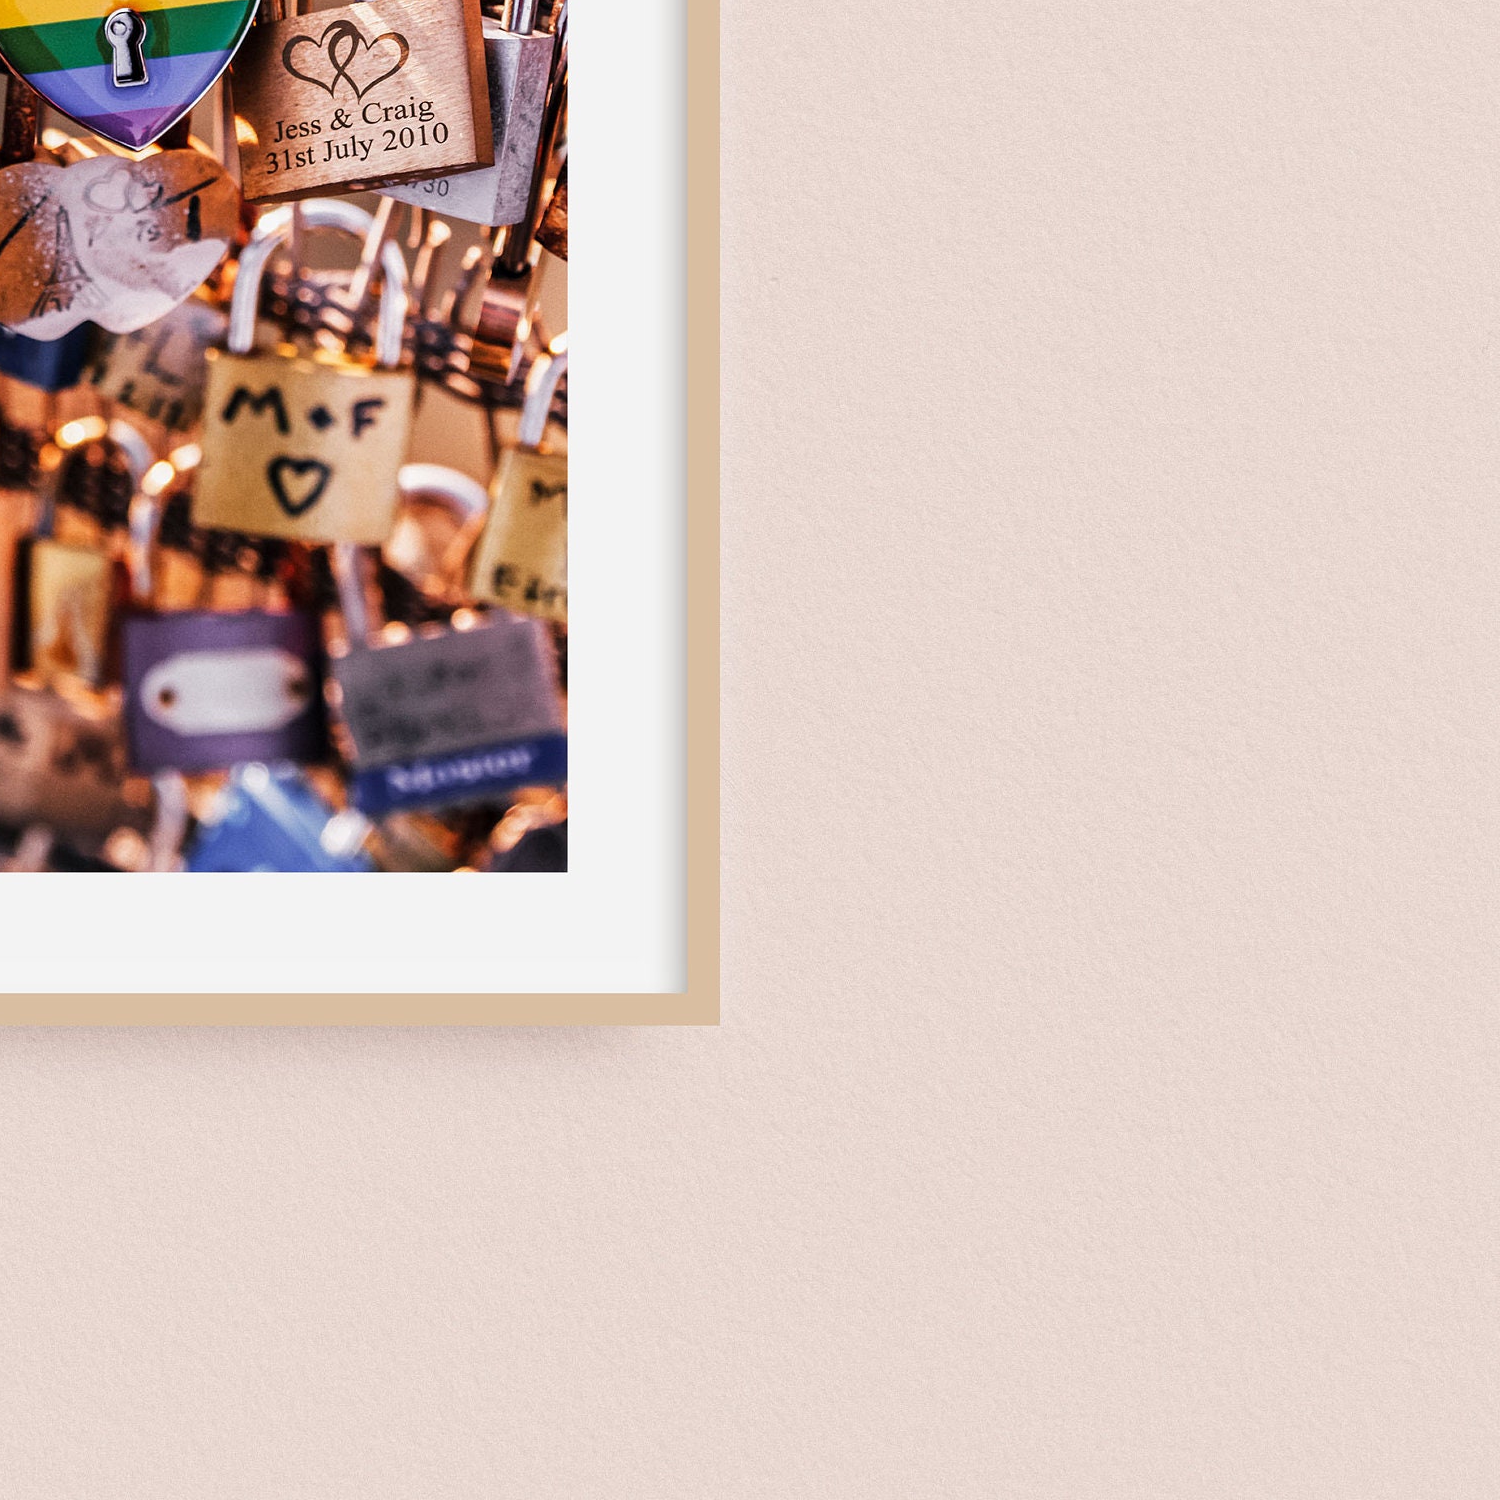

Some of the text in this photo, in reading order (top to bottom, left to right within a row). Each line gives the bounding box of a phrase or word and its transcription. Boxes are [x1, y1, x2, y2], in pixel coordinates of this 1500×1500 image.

[273, 96, 436, 143] Jess & Craig
[265, 121, 450, 174] 31st July 2010
[222, 384, 291, 436] M
[352, 399, 386, 438] F
